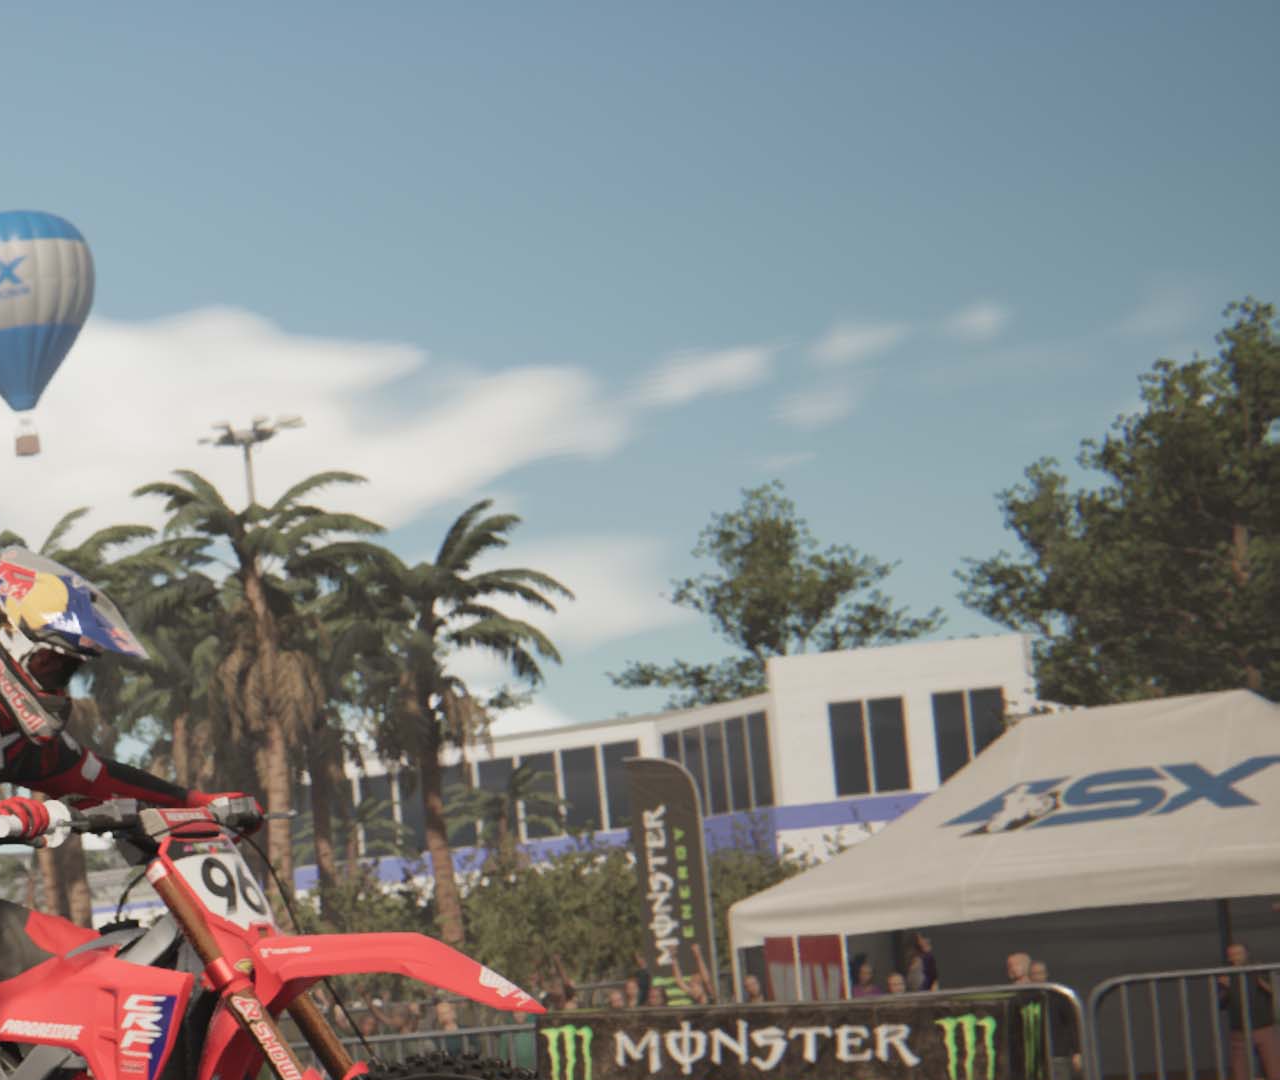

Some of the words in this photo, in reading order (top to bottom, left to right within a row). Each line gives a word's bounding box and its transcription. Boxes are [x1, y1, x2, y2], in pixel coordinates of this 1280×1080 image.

[643, 804, 681, 967] MONSTER
[673, 827, 695, 938] ENERGY
[613, 1020, 920, 1075] MONSTER
